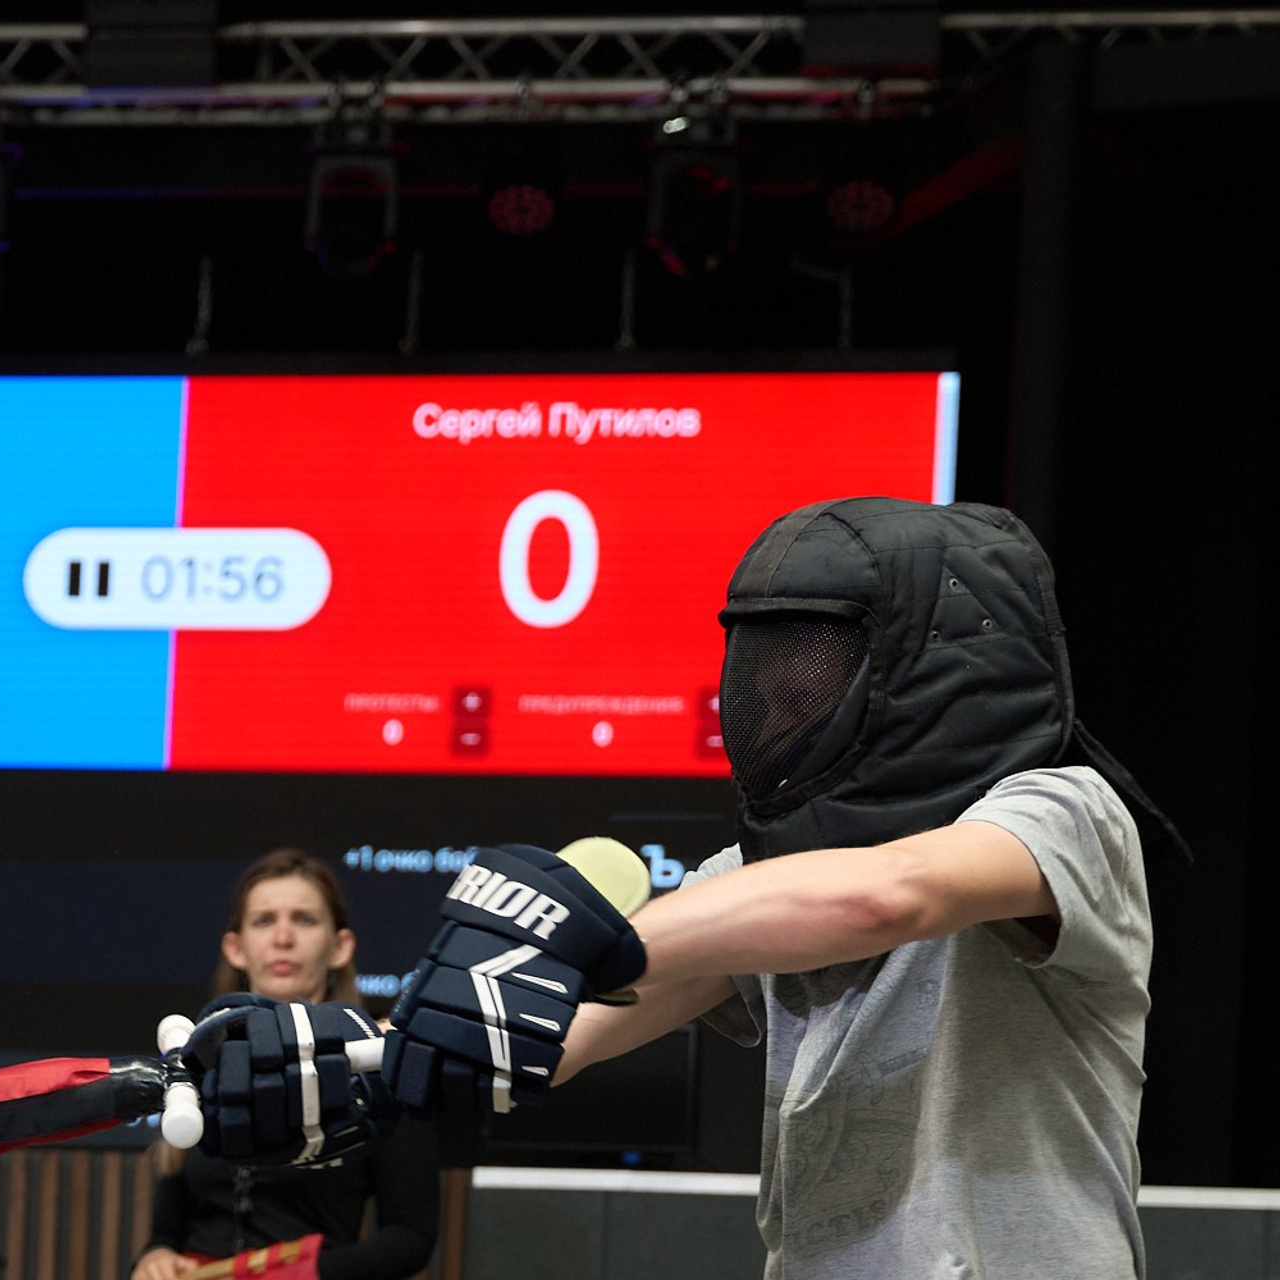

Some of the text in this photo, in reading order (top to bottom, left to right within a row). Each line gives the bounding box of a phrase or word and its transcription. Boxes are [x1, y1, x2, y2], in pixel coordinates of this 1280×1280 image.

[413, 402, 701, 445] Сергей Путилов
[141, 555, 285, 601] 01:56
[499, 490, 599, 628] 0
[446, 864, 570, 940] RIOR
